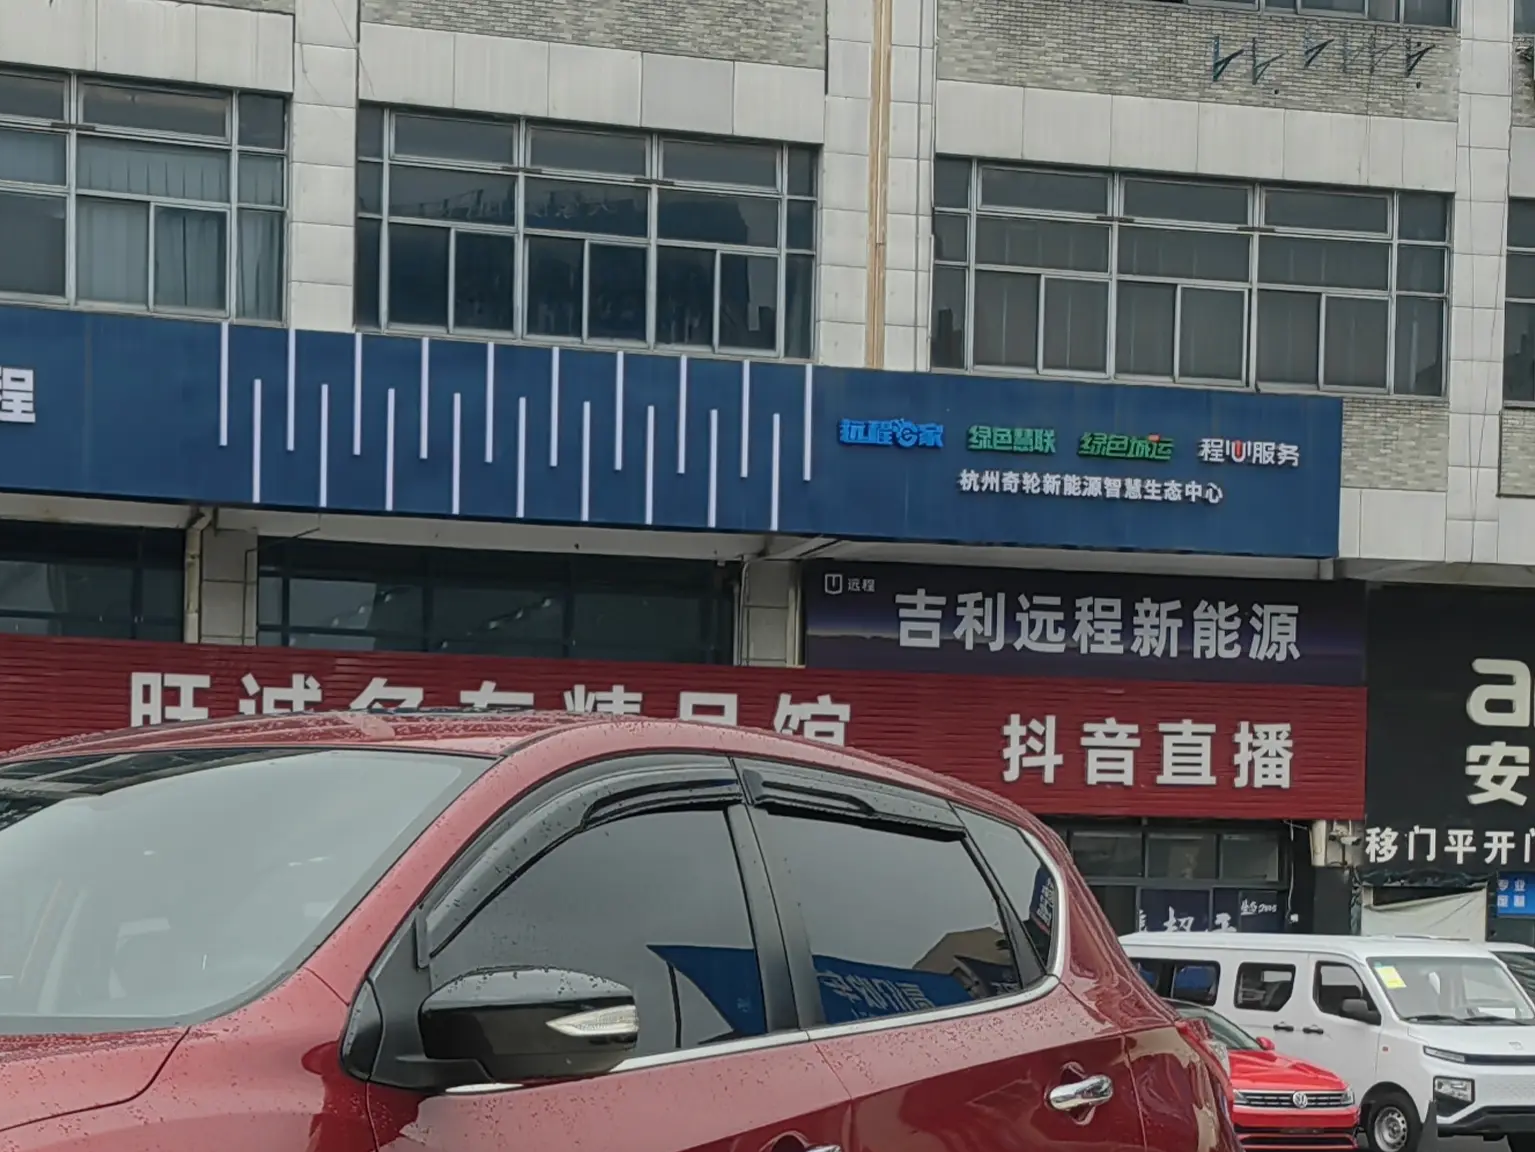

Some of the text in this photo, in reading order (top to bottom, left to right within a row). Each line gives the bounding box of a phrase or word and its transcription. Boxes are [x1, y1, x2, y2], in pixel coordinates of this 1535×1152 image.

[968, 424, 1056, 453] 绿色慧联
[958, 469, 1223, 504] 杭州奇轮新能源智慧生态中心
[847, 577, 876, 593] 远程
[895, 588, 1301, 663] 吉利远程新能源
[1466, 658, 1535, 727] a
[1002, 712, 1295, 790] 抖音直播
[1465, 741, 1530, 806] 安
